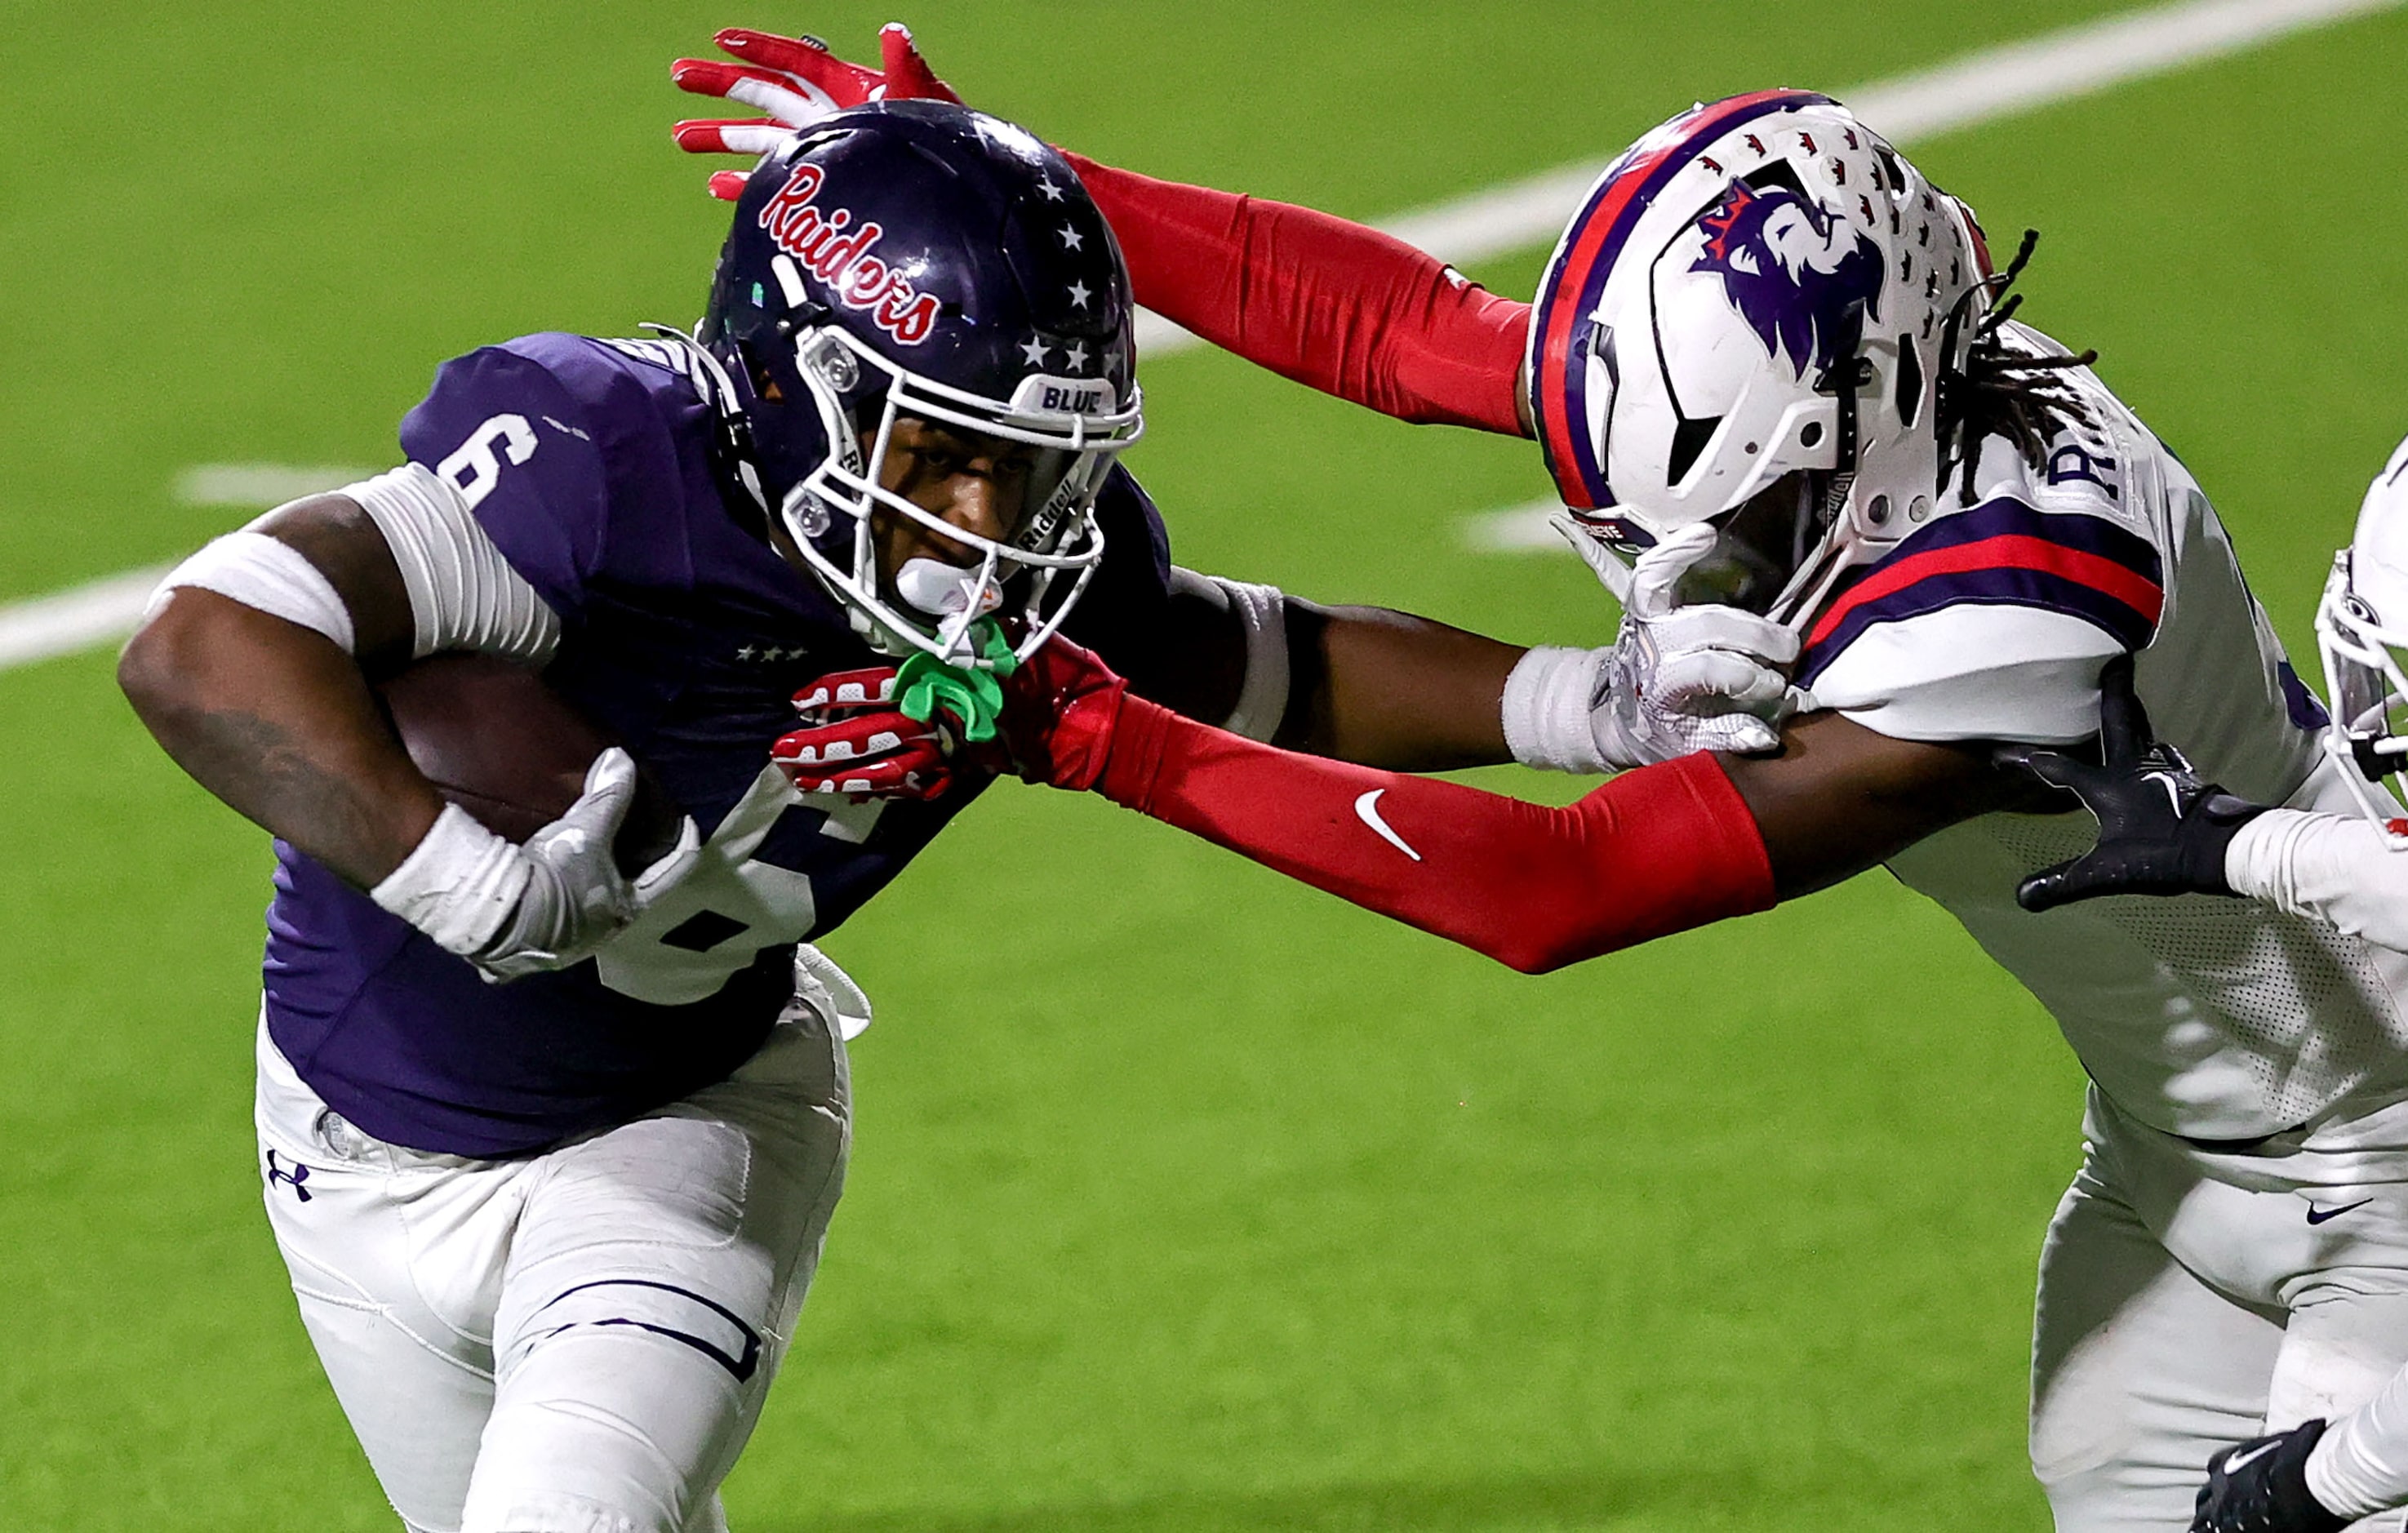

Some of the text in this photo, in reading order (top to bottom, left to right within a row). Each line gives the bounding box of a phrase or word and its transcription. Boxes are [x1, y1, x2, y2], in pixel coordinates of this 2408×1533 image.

[758, 163, 940, 346] Raiders
[1042, 386, 1102, 413] BLUE
[436, 413, 539, 513] 6
[1017, 478, 1073, 552] Riddell
[595, 762, 887, 1006] 6
